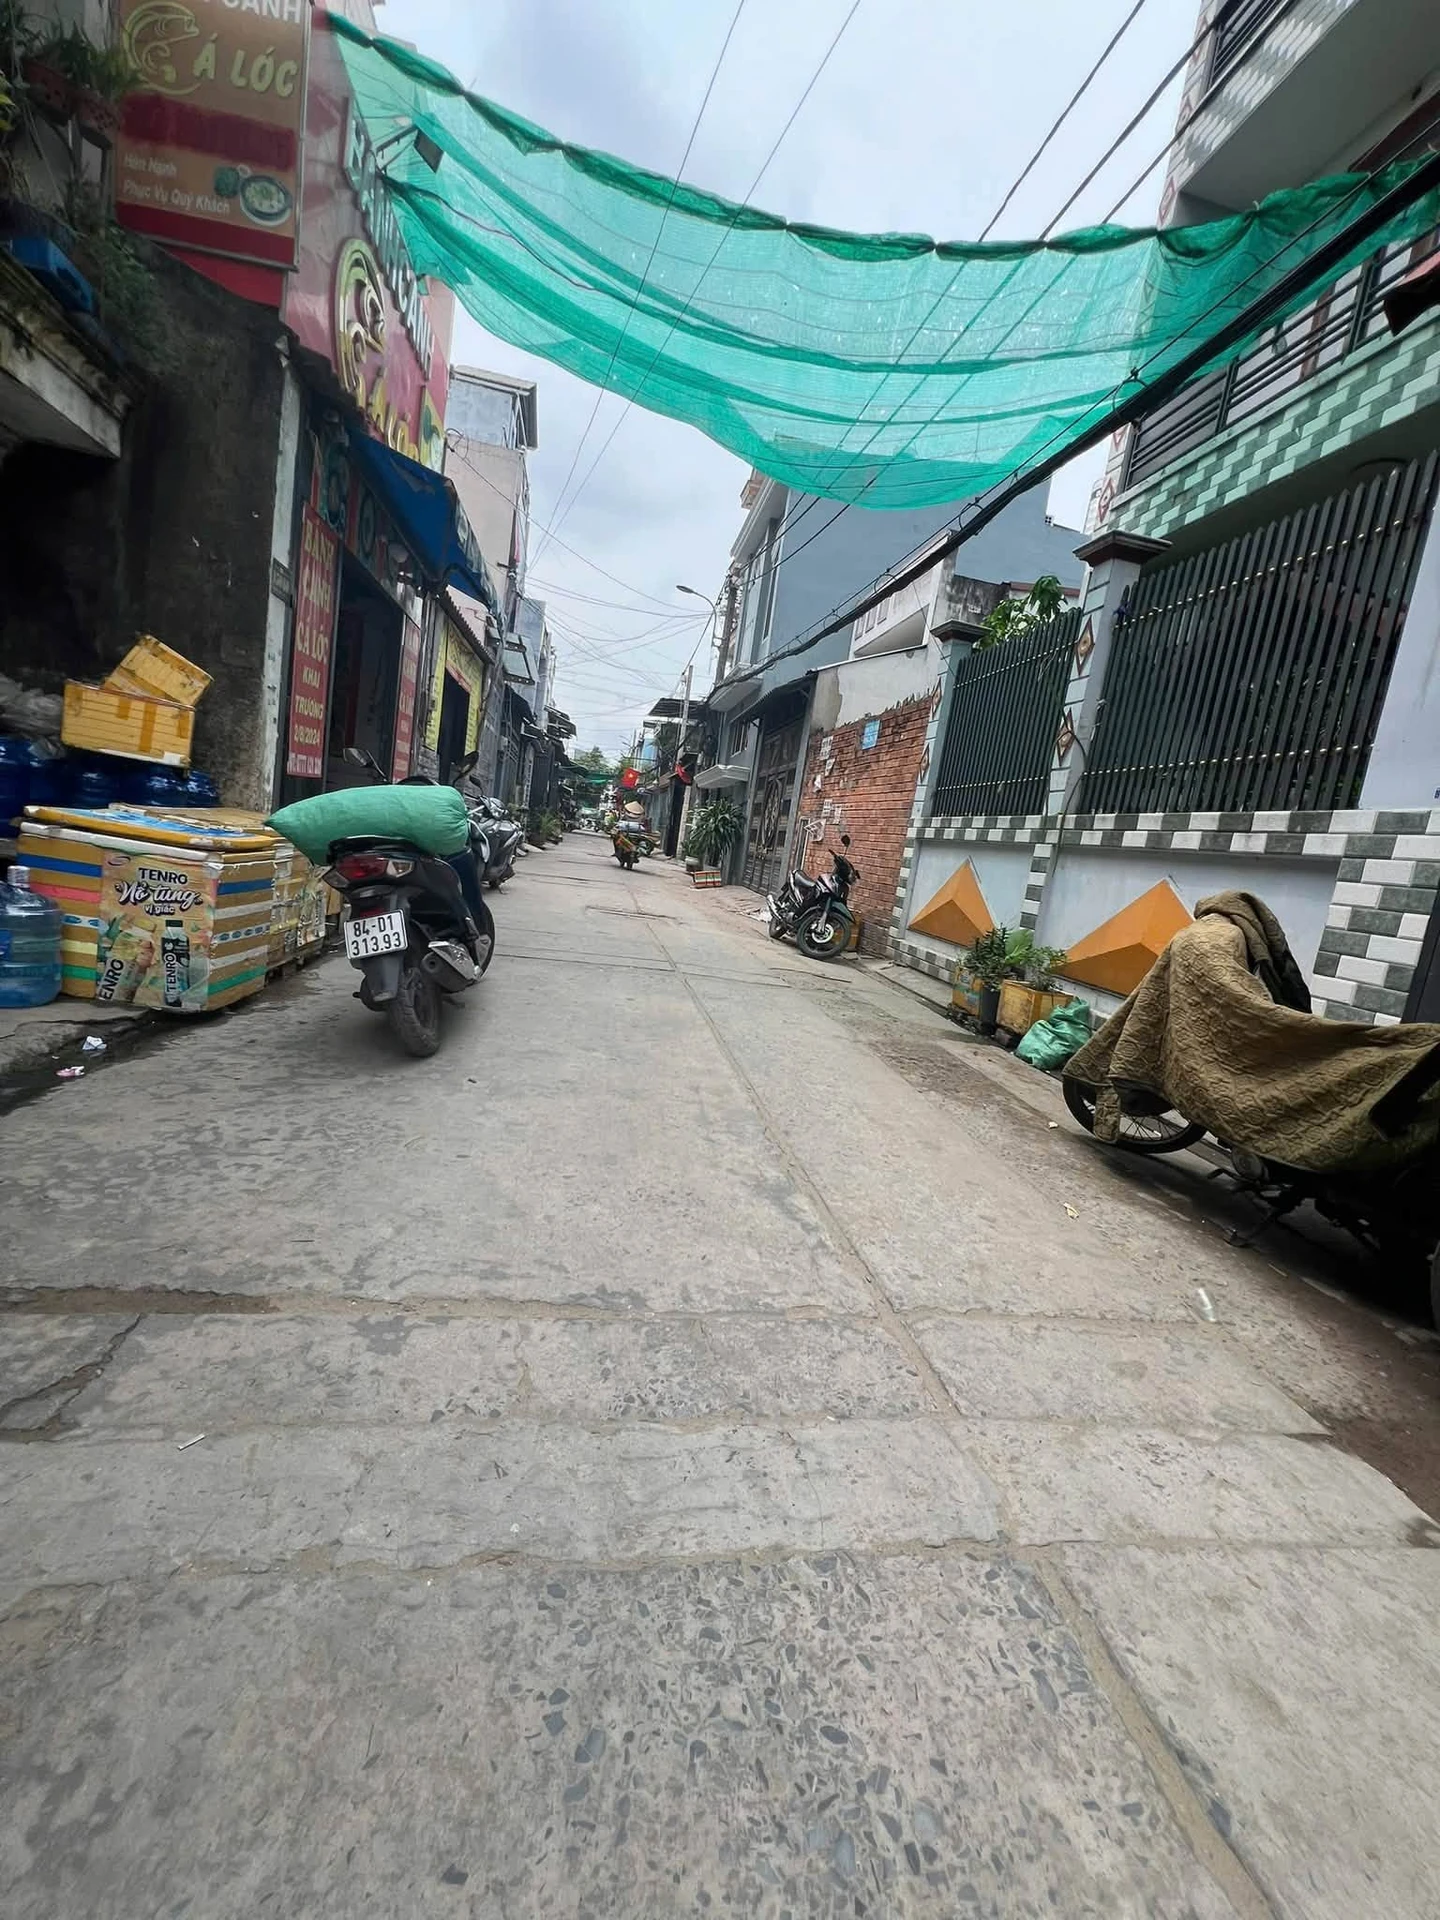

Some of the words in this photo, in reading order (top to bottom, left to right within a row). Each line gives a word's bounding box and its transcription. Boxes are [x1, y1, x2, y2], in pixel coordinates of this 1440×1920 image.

[230, 46, 298, 97] LÓC
[139, 867, 188, 885] TENRO
[353, 914, 394, 938] 84-D1
[351, 931, 401, 956] 313.93
[165, 953, 177, 992] TENRO
